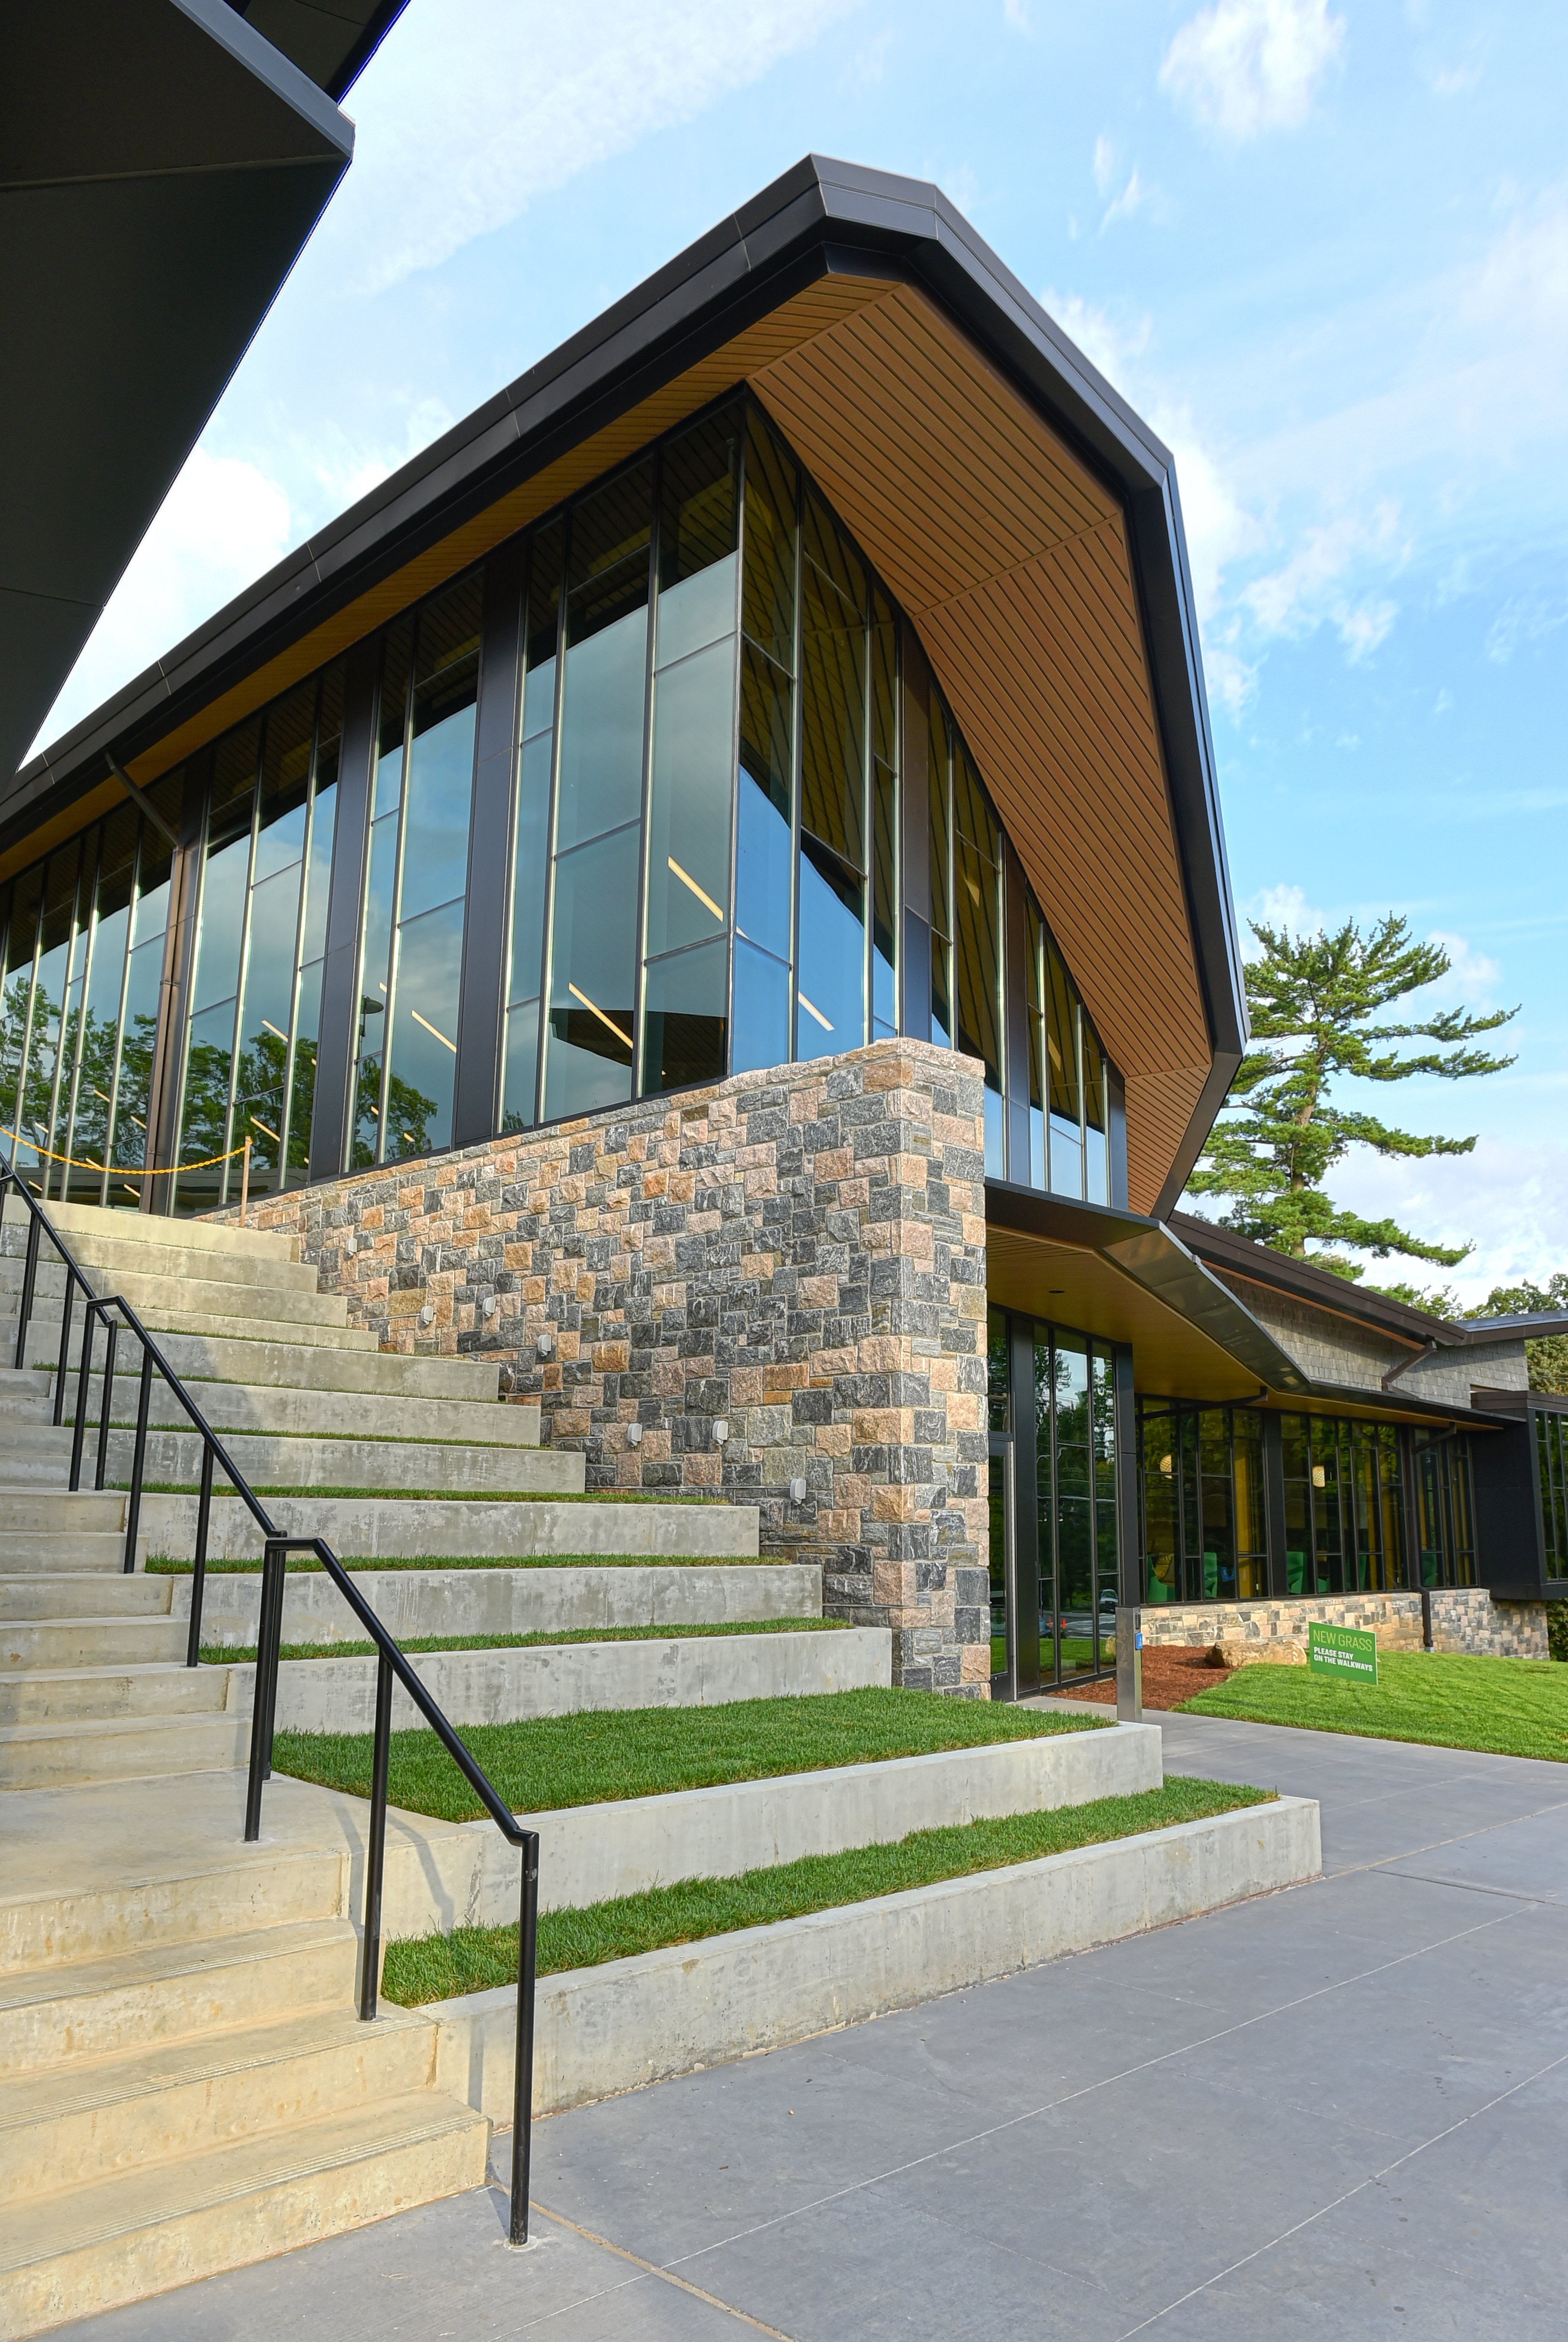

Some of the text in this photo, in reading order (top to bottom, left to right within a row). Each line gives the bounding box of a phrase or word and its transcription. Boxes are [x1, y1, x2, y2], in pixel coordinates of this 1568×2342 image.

[1313, 1629, 1372, 1652] NEW GRASS
[1314, 1647, 1354, 1660] PLEASE STAY
[1314, 1654, 1373, 1672] ON THE WALKWAYS
